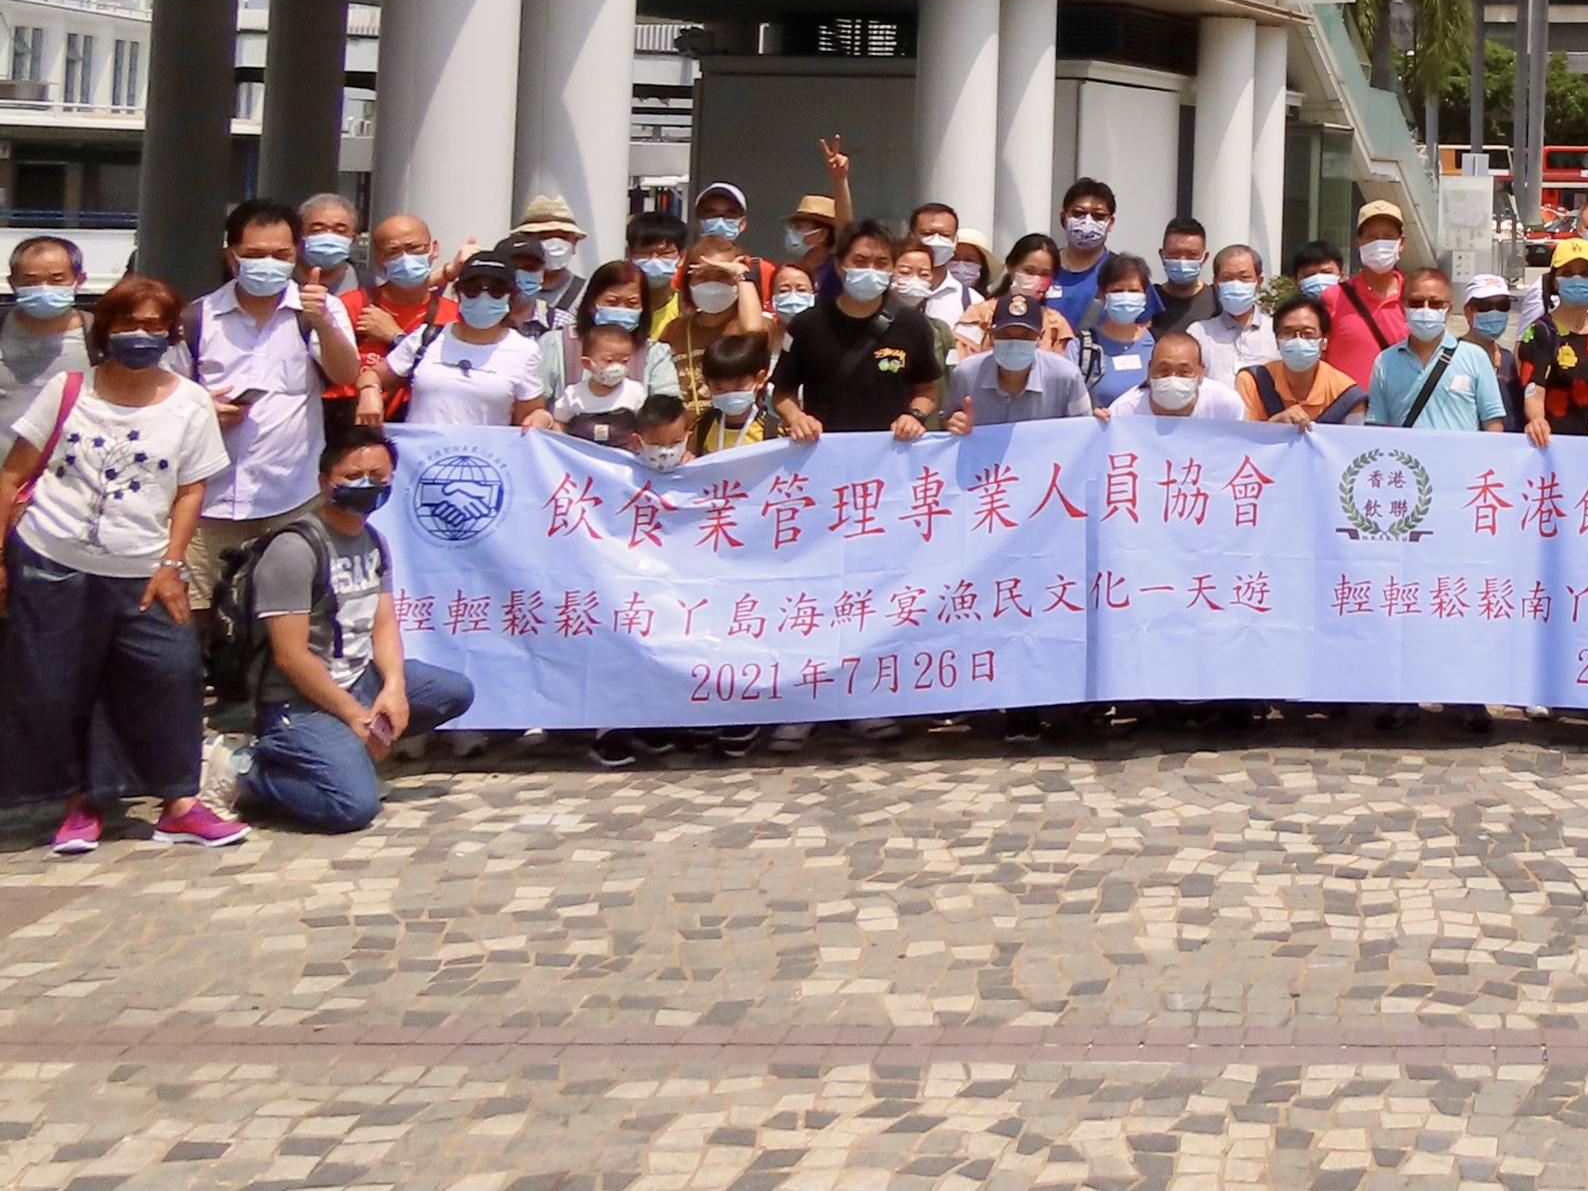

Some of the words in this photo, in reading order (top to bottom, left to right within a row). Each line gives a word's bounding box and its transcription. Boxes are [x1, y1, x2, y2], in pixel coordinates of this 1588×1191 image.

[544, 452, 1275, 552] 飲食業管理專業人員協會
[1367, 469, 1406, 489] 香港
[394, 571, 1273, 639] 輕輕鬆鬆南丫島海鮮宴漁民文化一天遊
[690, 649, 998, 703] 2021年7月26日
